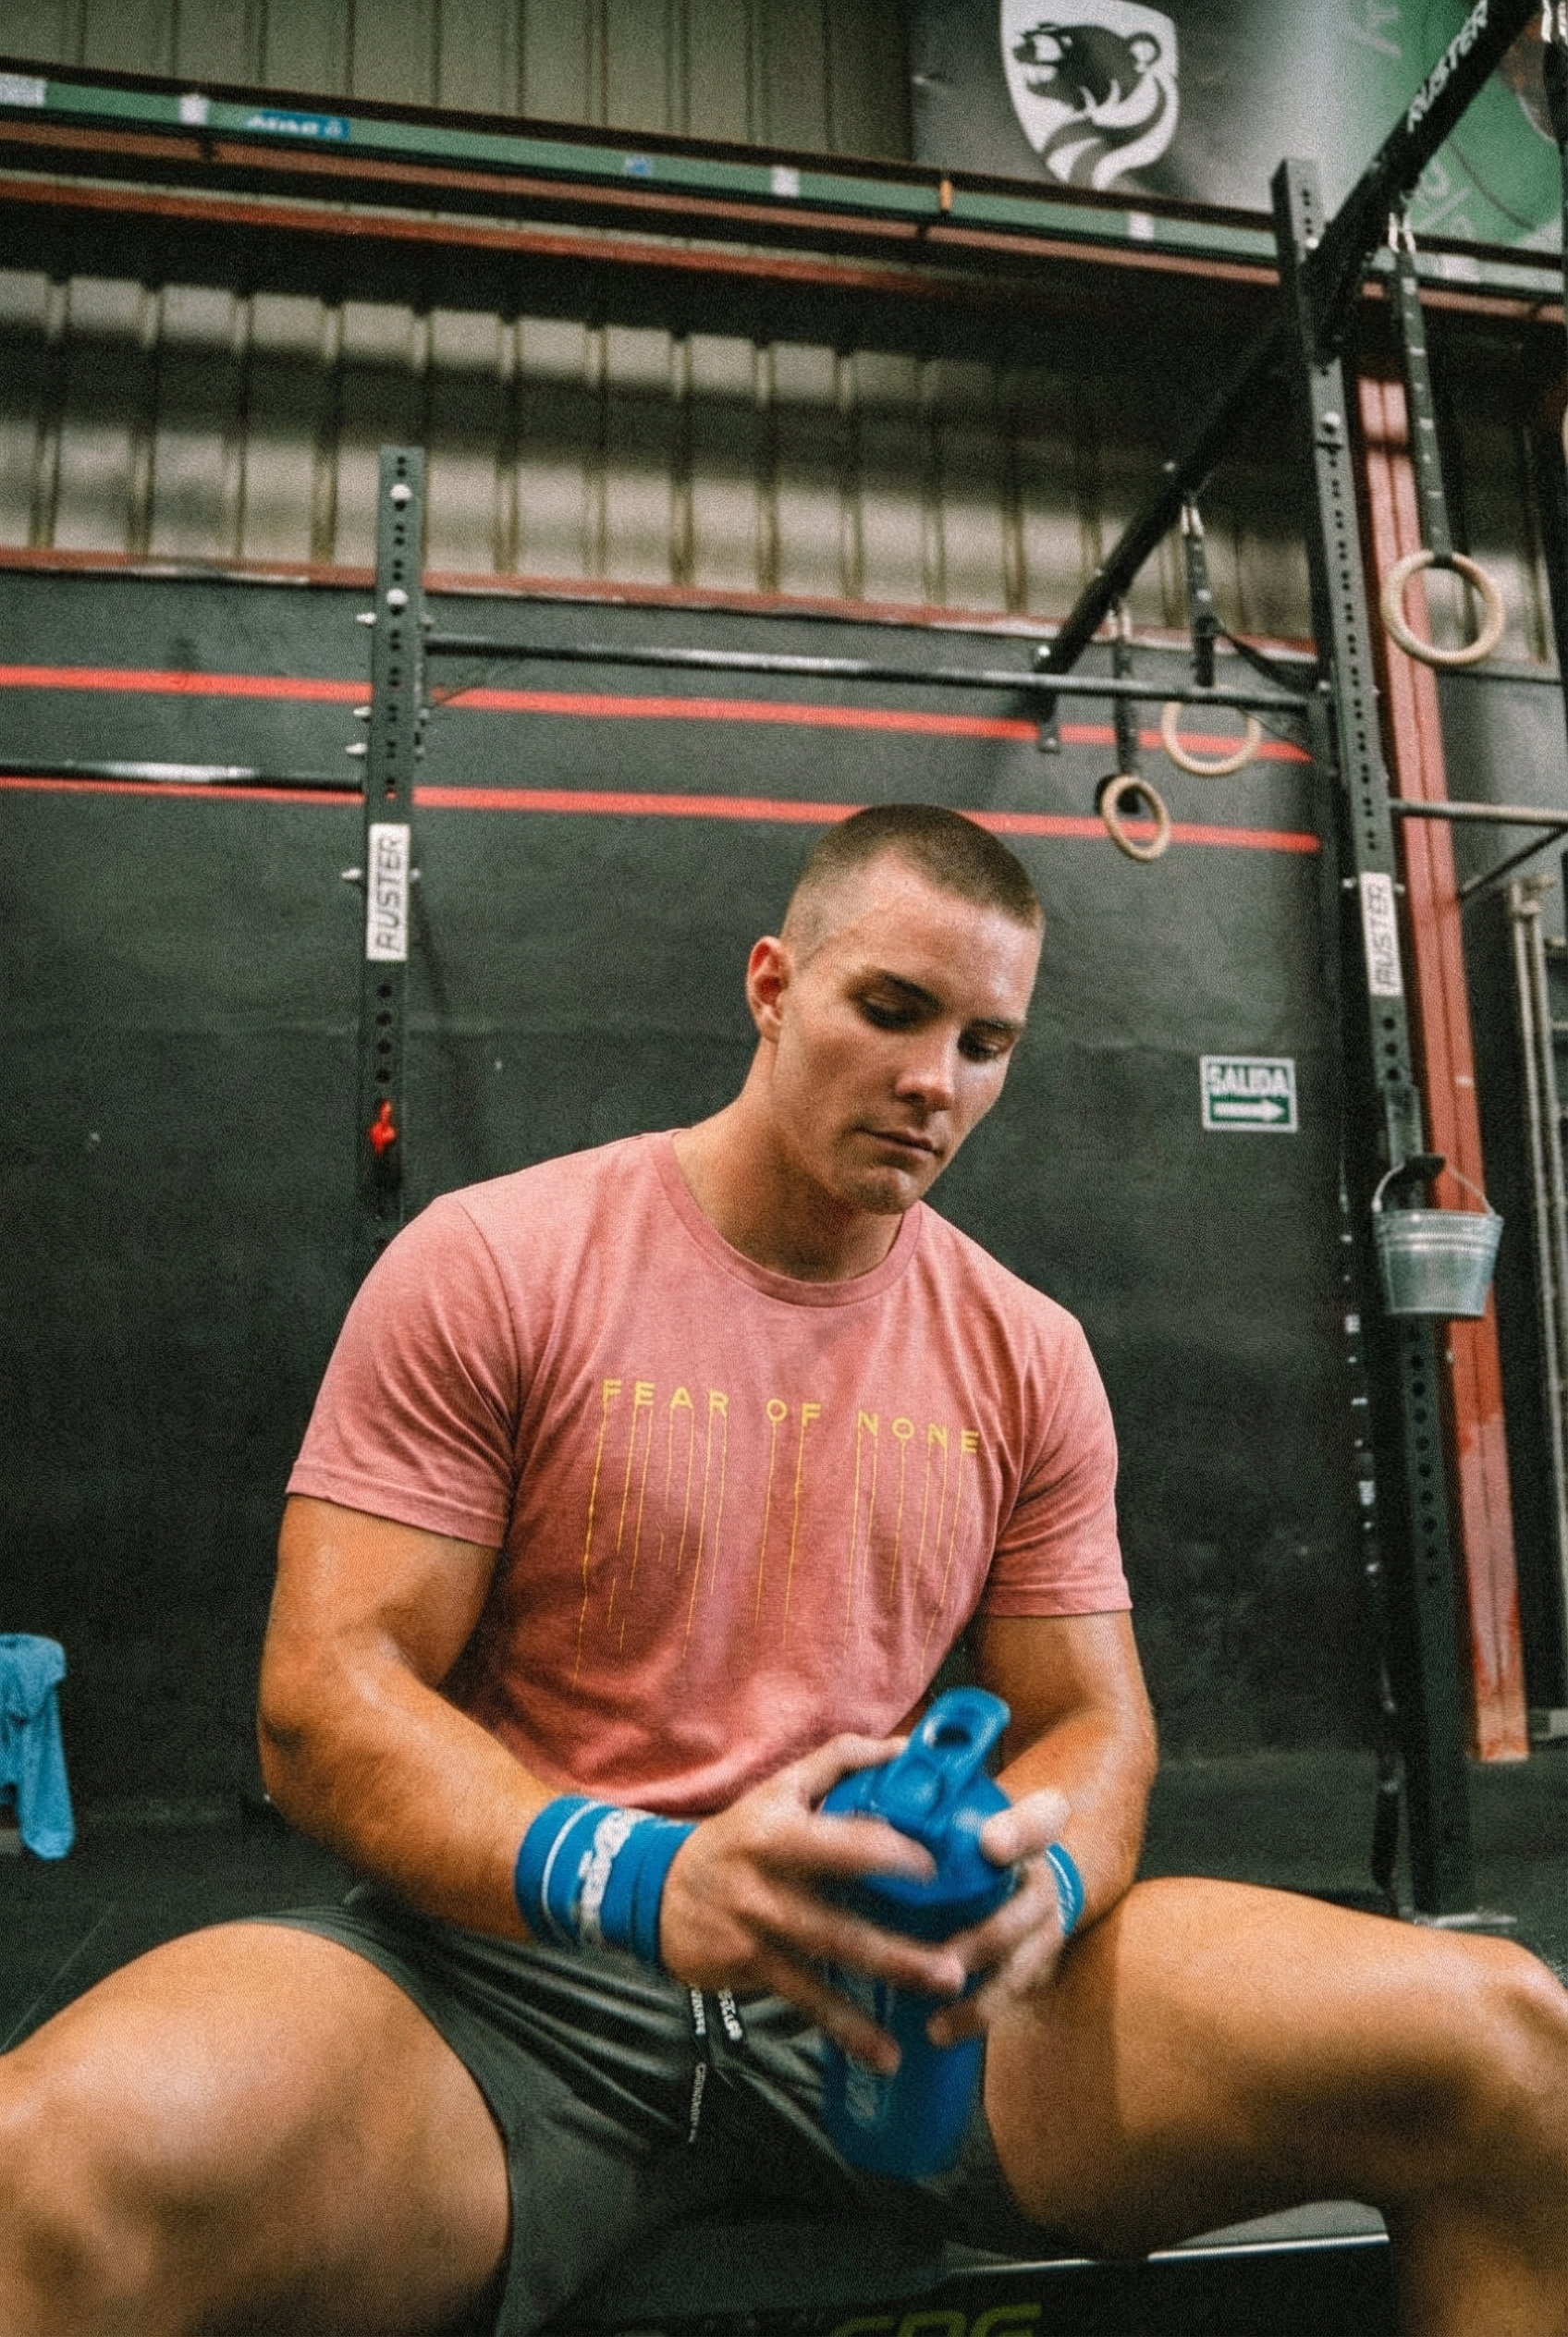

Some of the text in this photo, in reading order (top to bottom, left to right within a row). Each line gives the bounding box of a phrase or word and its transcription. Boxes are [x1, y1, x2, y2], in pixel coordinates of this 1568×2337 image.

[375, 836, 401, 952] RUSTER
[1367, 884, 1396, 987] RUSTER
[1206, 1064, 1291, 1095] SALIDA
[602, 1378, 979, 1453] FEAR OF NONE
